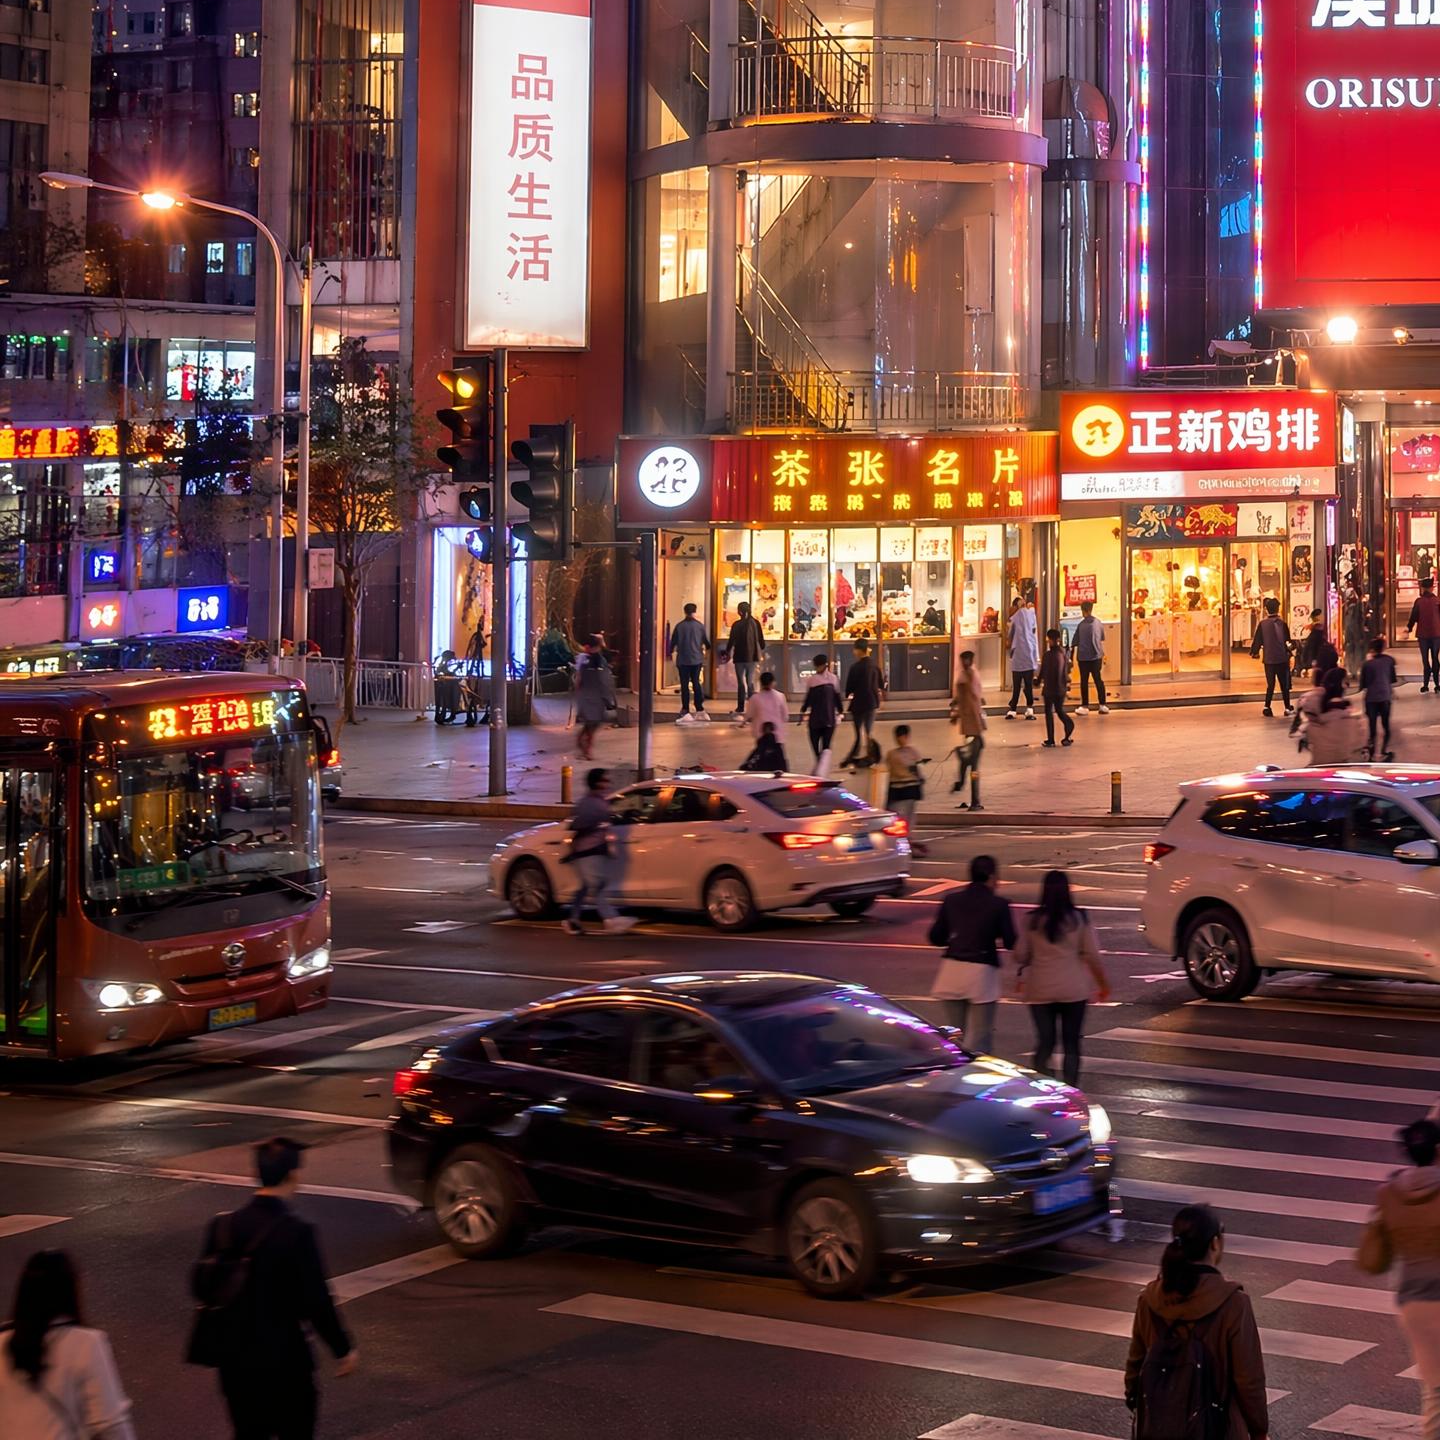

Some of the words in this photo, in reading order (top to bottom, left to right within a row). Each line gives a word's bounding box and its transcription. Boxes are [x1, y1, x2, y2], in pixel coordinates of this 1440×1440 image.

[506, 53, 553, 282] 品质生活
[1127, 407, 1321, 454] 正新鸡排
[771, 448, 1021, 488] 茶张名片
